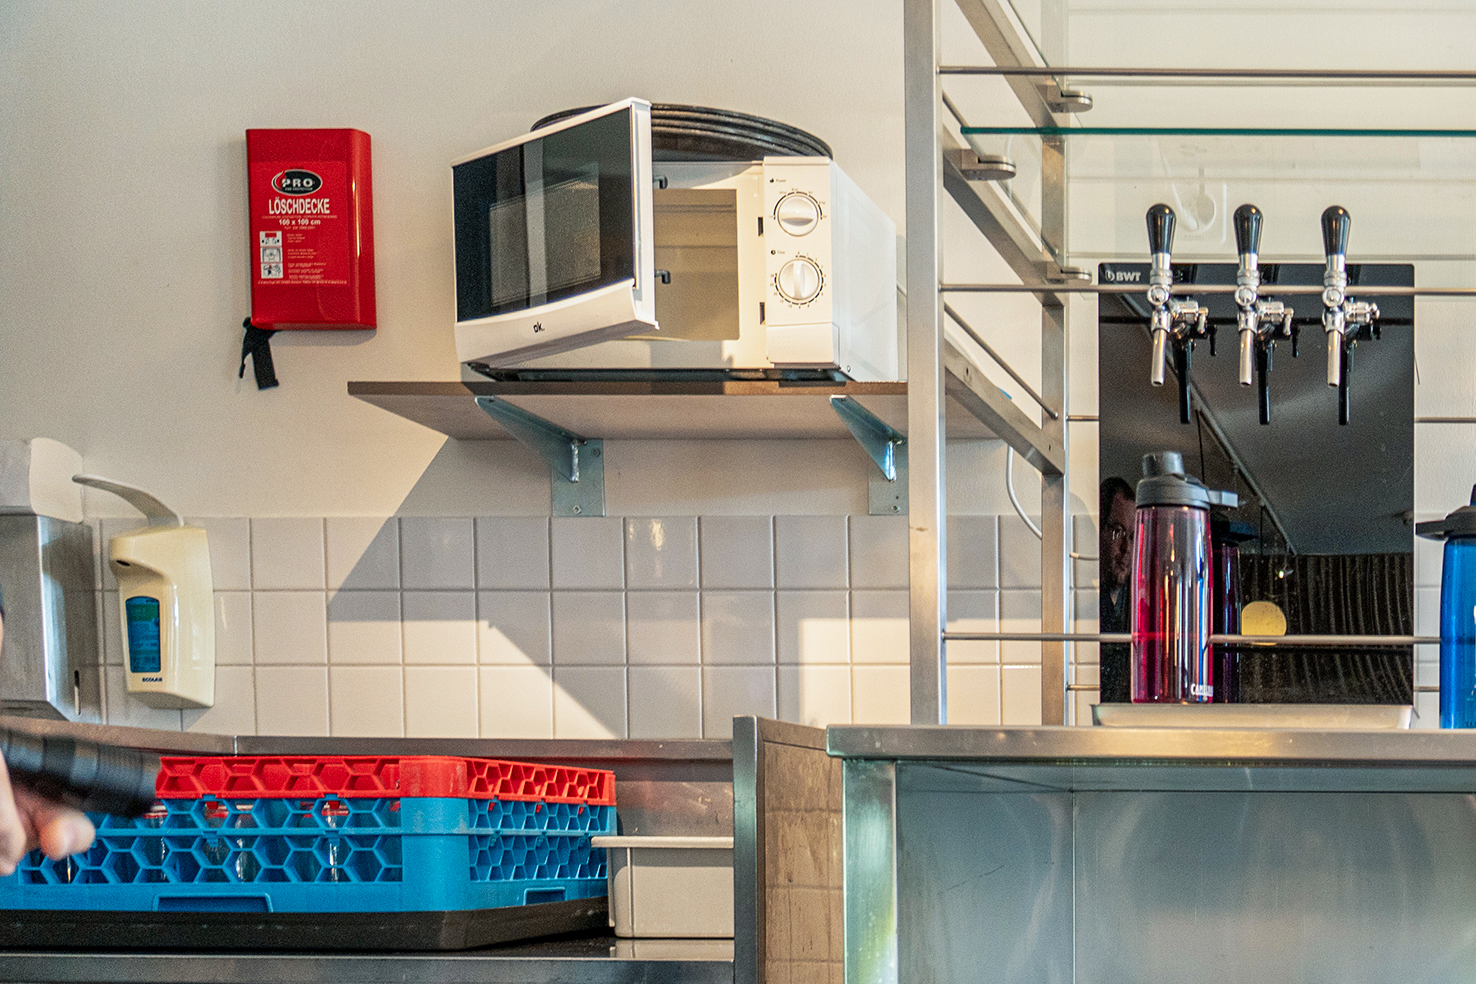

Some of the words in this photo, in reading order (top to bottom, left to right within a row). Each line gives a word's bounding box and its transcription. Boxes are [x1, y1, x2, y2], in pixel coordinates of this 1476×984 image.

[281, 178, 314, 188] PRO
[268, 196, 331, 215] LÖSCHDECKE
[1115, 271, 1141, 282] BWT
